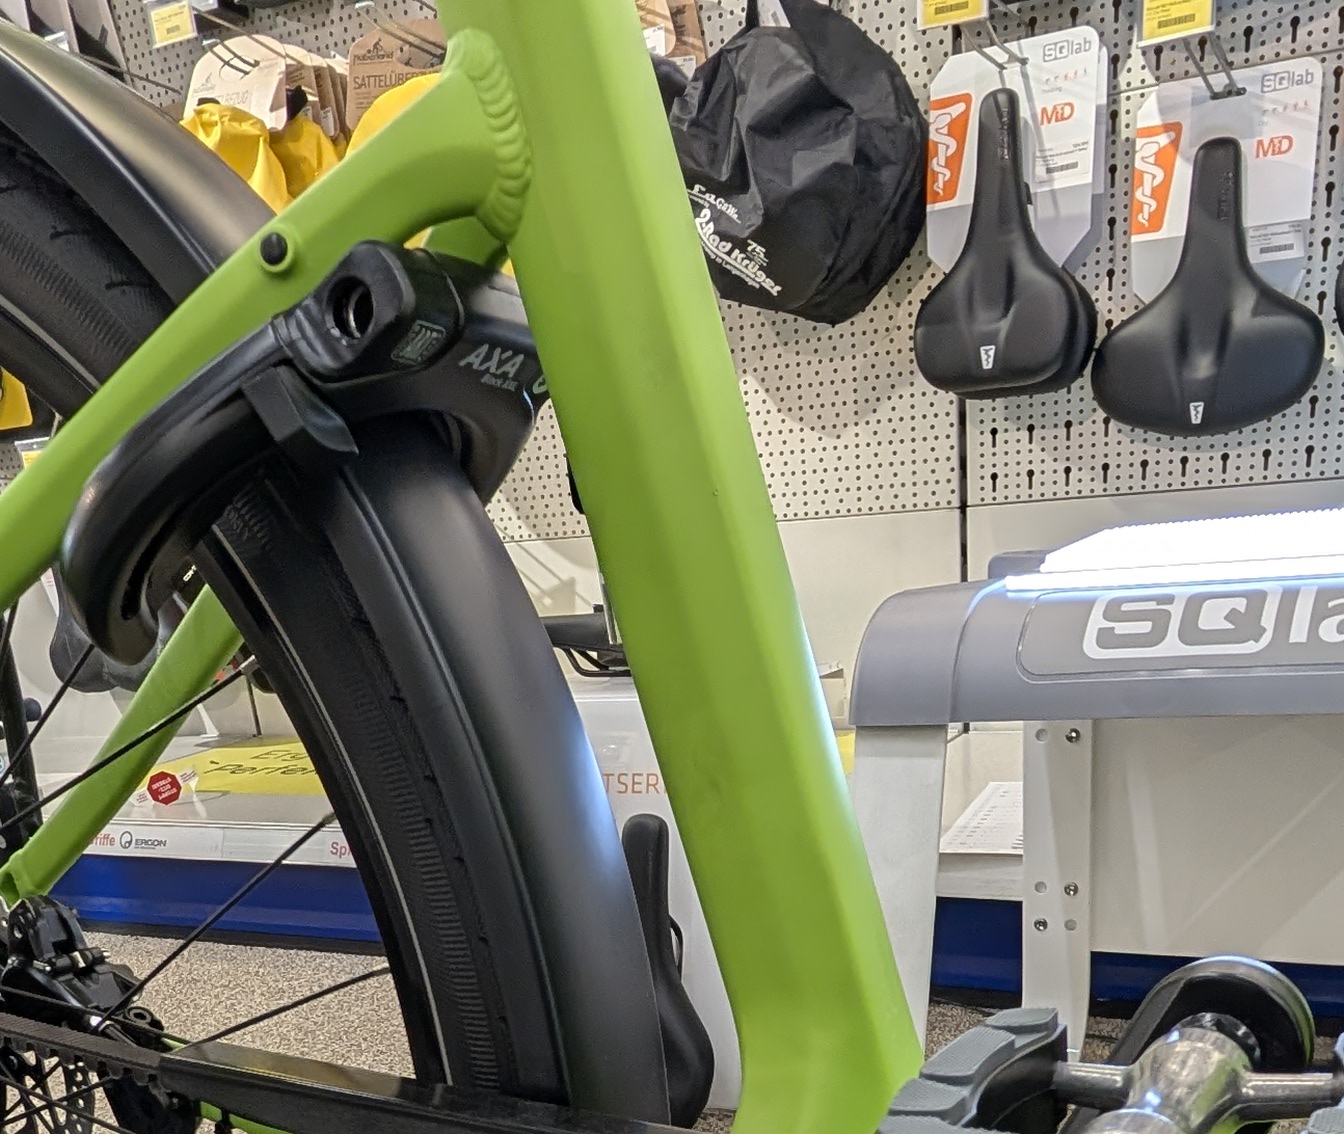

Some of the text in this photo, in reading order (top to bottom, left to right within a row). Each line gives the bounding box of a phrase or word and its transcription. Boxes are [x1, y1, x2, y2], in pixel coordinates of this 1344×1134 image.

[1043, 37, 1092, 62] SQlab
[1261, 69, 1314, 93] SQlab
[459, 343, 524, 377] AXA
[135, 838, 167, 847] ERGON
